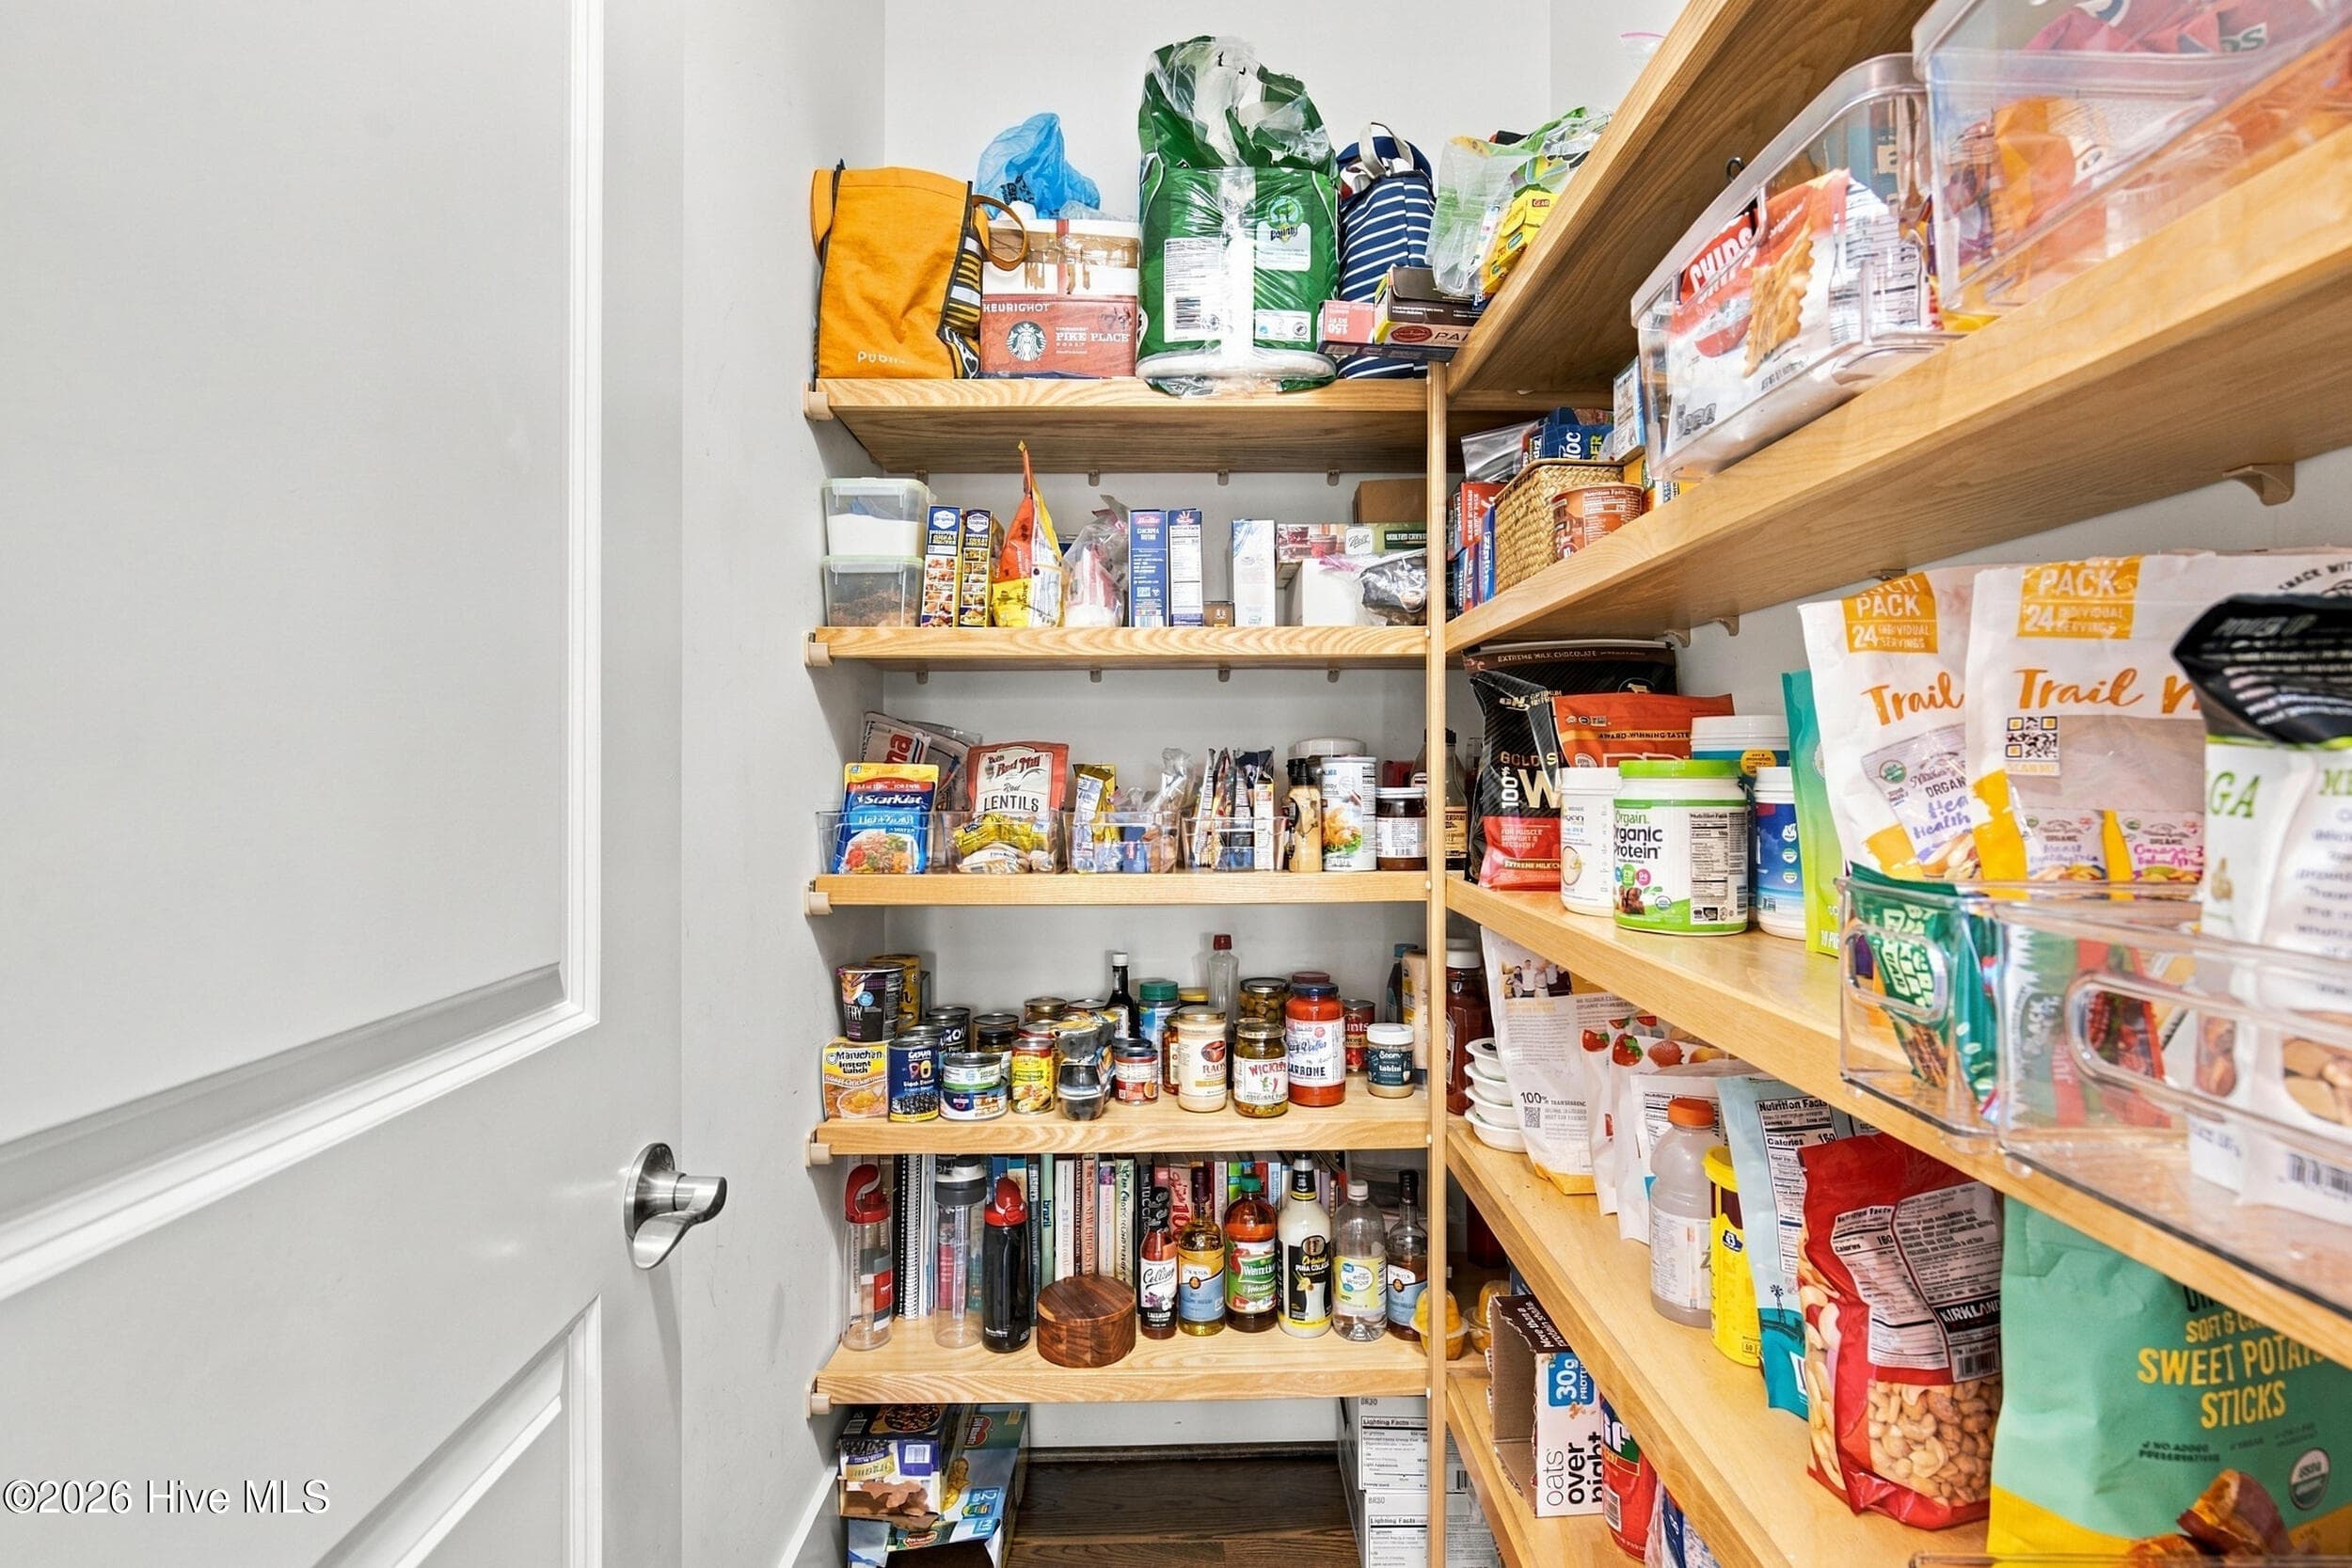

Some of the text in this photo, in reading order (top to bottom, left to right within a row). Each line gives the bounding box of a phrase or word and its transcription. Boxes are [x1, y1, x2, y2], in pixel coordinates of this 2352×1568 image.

[1056, 332, 1129, 342] PIKE PLACE
[2037, 568, 2118, 597] PACK
[1856, 594, 1921, 618] PACK
[2024, 604, 2055, 632] 24
[1851, 625, 1879, 649] 24
[1497, 653, 1533, 663] EXTREME
[2013, 667, 2145, 710] Trail
[1861, 672, 1964, 726] Trail
[996, 759, 1018, 778] Red
[1500, 752, 1540, 767] GOLD
[1501, 766, 1519, 808] 100%
[864, 794, 923, 805] StarKist
[984, 795, 1040, 812] LENTILS
[1515, 828, 1543, 836] MUSCLE
[1913, 812, 1972, 839] Health
[836, 1050, 882, 1061] Maruchan
[908, 1050, 931, 1060] GOYA
[1520, 1091, 1549, 1105] 100%
[1759, 1099, 1828, 1111] Nutrition Facts
[1767, 1133, 1836, 1146] Calories 160
[1042, 1200, 1051, 1227] brazil
[1836, 1243, 1861, 1252] Calories
[1876, 1235, 1893, 1246] 160
[1521, 1312, 1538, 1329] than
[2185, 1315, 2222, 1344] SOFT
[1535, 1329, 1555, 1348] More
[2137, 1343, 2234, 1386] SWEET
[1556, 1359, 1578, 1400] 30g
[2200, 1380, 2287, 1431] STICKS
[1542, 1450, 1565, 1507] oats
[1567, 1442, 1585, 1505] over
